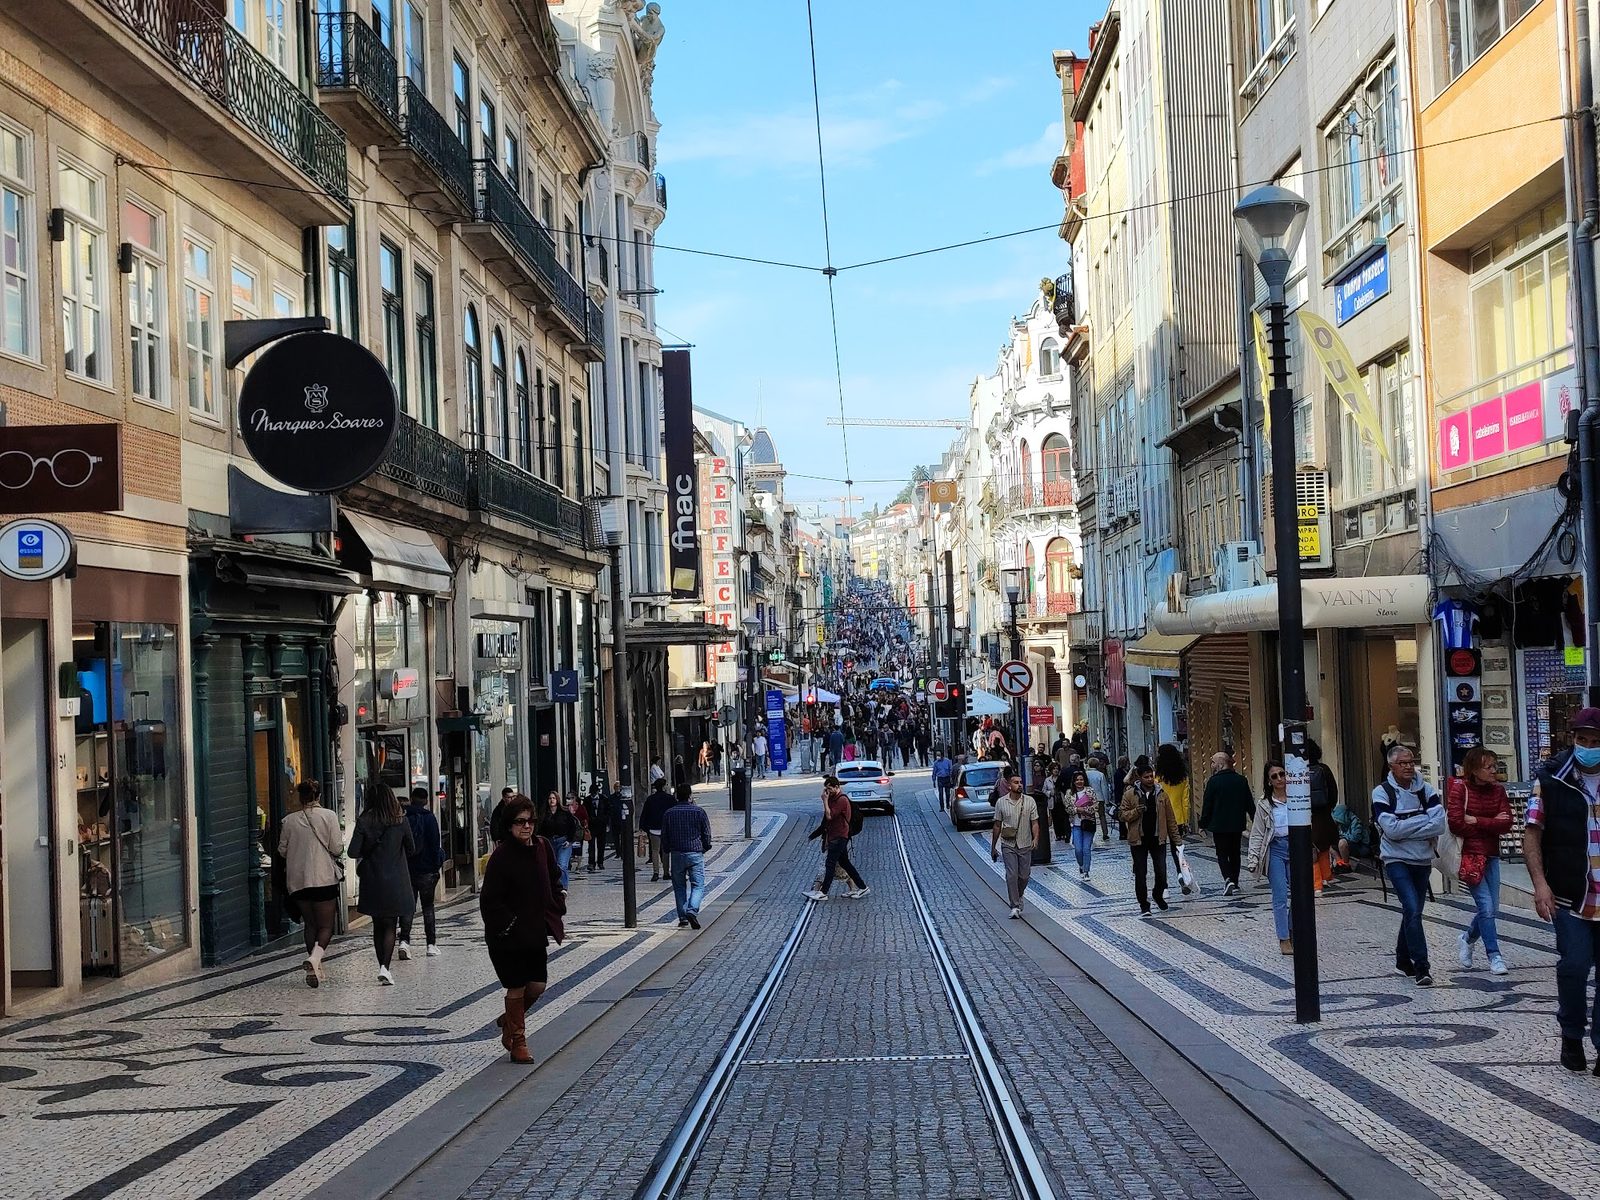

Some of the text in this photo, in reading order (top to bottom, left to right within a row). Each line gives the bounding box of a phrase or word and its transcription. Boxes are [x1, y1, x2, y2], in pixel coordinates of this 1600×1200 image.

[251, 408, 384, 434] Marques Soares
[671, 474, 694, 552] fnac
[712, 458, 733, 653] PERFECTA
[1317, 588, 1399, 607] VANNY
[1375, 607, 1400, 617] Store
